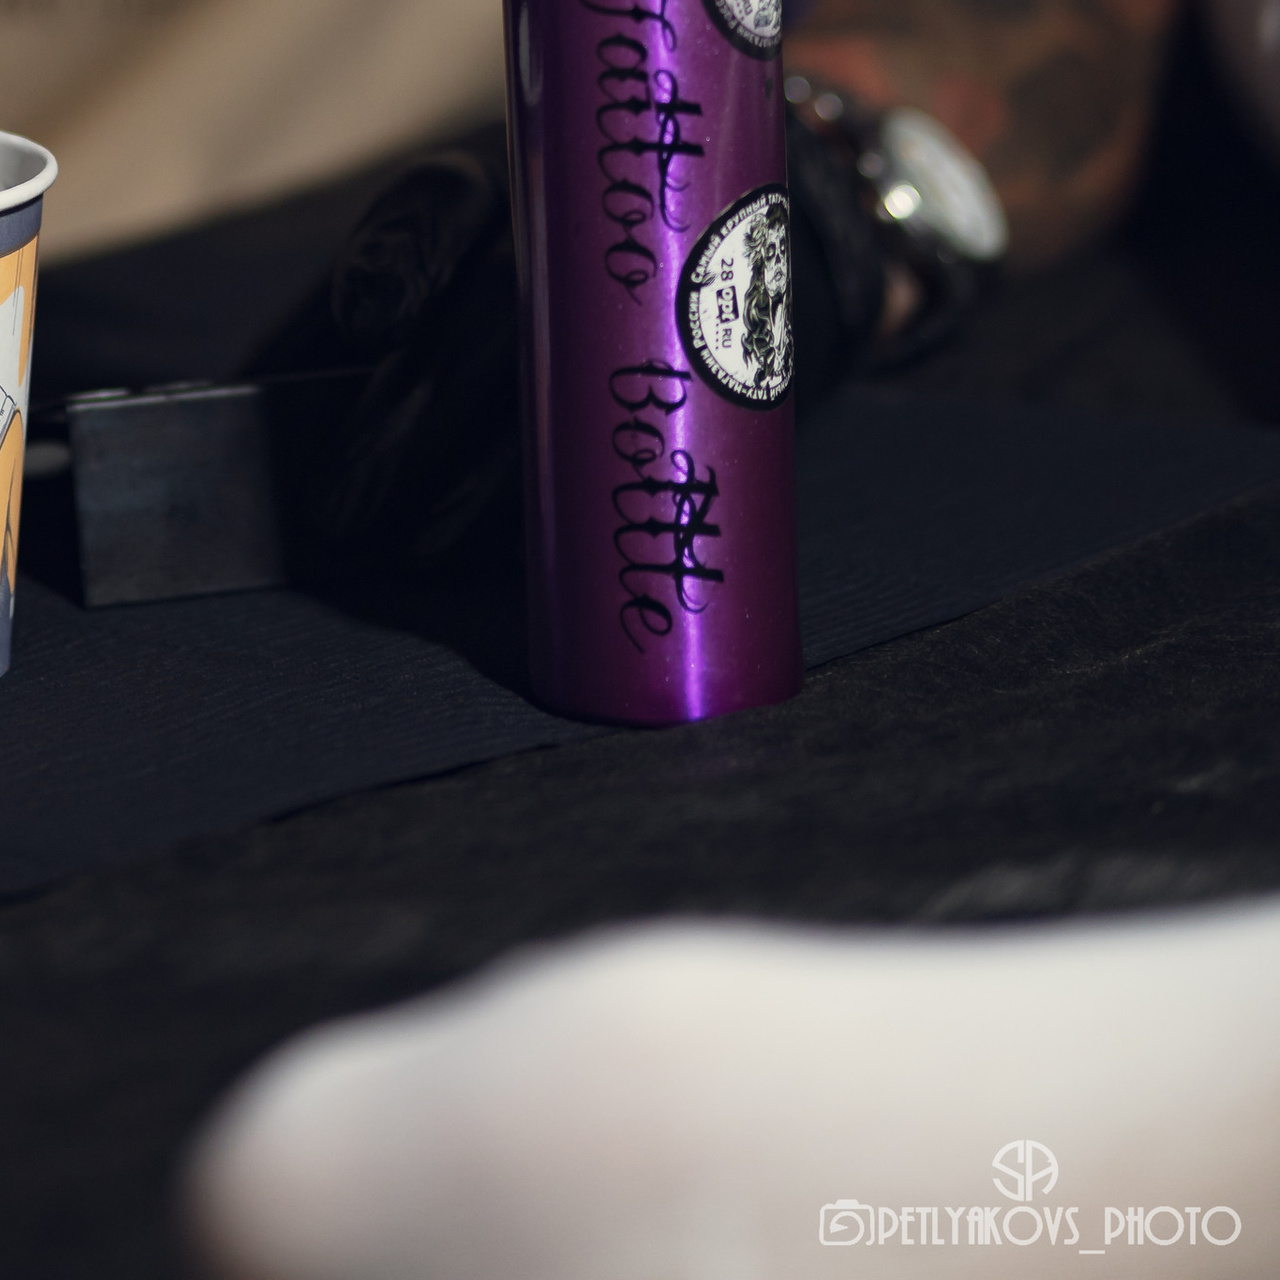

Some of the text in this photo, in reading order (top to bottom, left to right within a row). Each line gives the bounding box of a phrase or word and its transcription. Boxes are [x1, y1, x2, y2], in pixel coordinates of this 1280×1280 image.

[716, 257, 740, 350] 28 opt RU
[608, 360, 725, 655] Bottle
